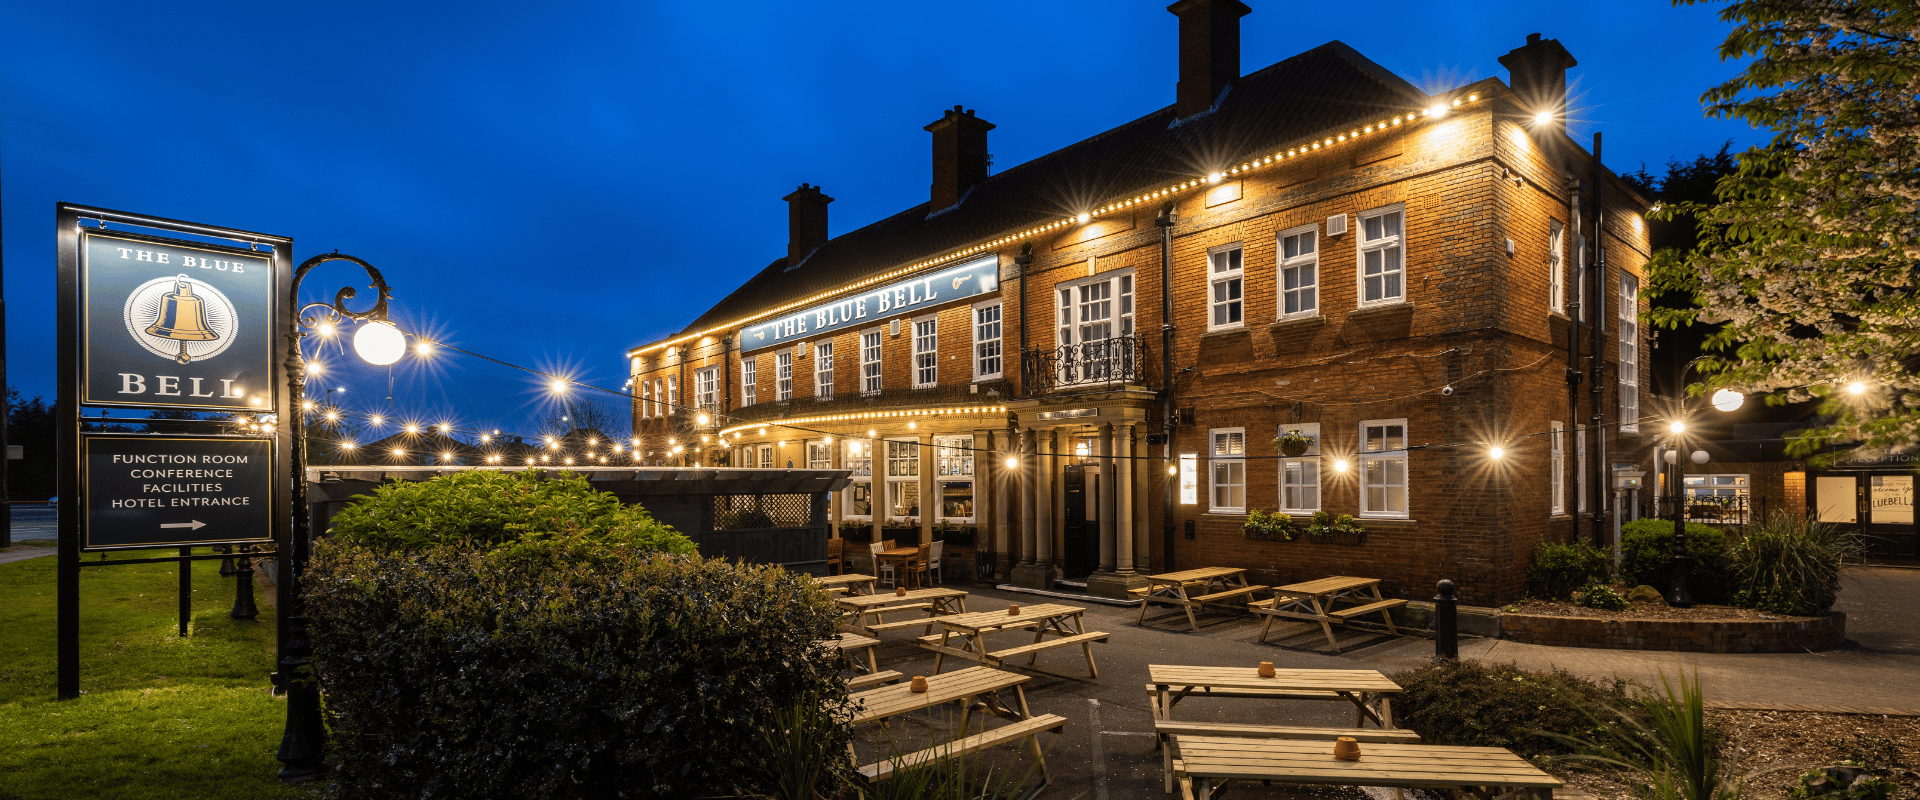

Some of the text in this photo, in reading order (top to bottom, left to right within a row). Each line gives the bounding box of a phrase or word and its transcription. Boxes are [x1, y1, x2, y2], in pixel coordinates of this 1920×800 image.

[117, 247, 245, 273] THE BLUE
[772, 277, 938, 340] THE BLUE BELL
[117, 372, 244, 399] BELL
[113, 454, 248, 464] FUNCTION ROOM
[130, 469, 233, 478] CONFERENCE
[143, 483, 223, 493] FACILITIES
[112, 496, 250, 508] HOTEL ENTRANCE
[1872, 496, 1909, 508] LUEBELL
